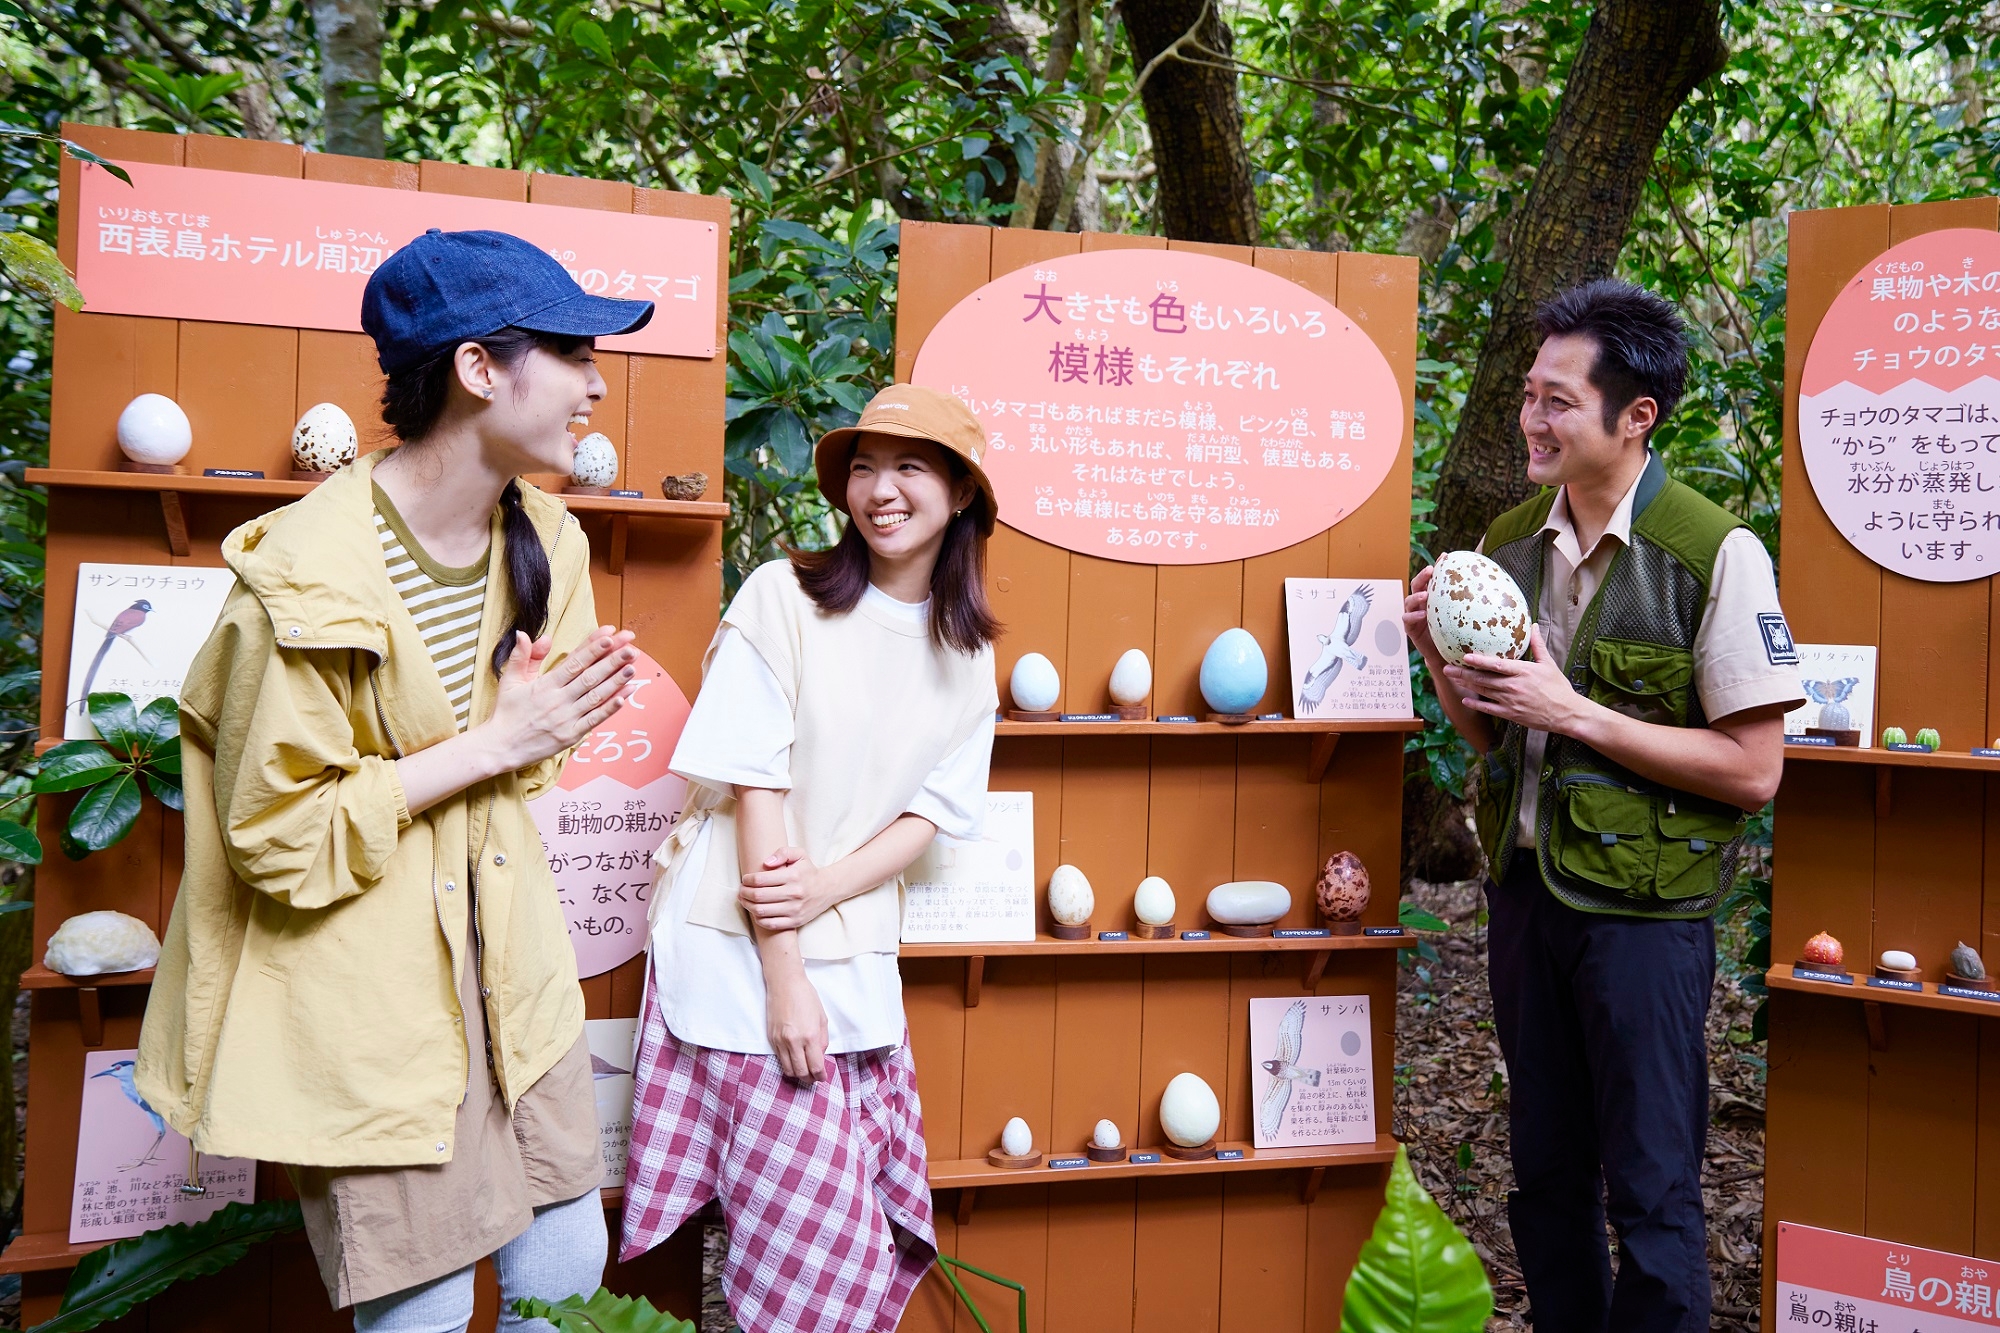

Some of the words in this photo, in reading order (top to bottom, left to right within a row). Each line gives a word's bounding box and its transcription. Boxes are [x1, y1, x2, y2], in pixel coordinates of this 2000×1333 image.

[98, 206, 211, 229] いりおもてじま
[315, 225, 389, 245] しゅうへん
[98, 221, 394, 276] 西表島ホテル周辺
[1874, 260, 1924, 276] くだもの
[1962, 256, 1974, 270] き
[1033, 268, 1057, 282] おお
[1156, 280, 1179, 292] いろ
[1869, 270, 2000, 302] 果物や木の
[1022, 282, 1327, 339] 大きさも色もいろいろ
[1893, 305, 2000, 334] のような
[1075, 327, 1109, 342] もよう
[1047, 341, 1281, 391] 模様もそれぞれ
[1184, 400, 1213, 411] もよう
[1290, 407, 1309, 418] いろ
[1329, 409, 1366, 421] あおいろ
[1820, 402, 1999, 428] チョウのタマゴは、
[1029, 422, 1047, 434] まる
[1065, 425, 1093, 437] かたち
[1187, 432, 1240, 445] だえんがた
[1260, 436, 1304, 450] たわらがた
[1072, 463, 1246, 491] それはなぜでしょう。
[1850, 461, 1896, 472] すいぶん
[1919, 460, 1975, 472] じょうはつ
[1847, 471, 2000, 495] 水分が蒸発し
[1034, 485, 1054, 497] いろ
[1078, 488, 1108, 500] もよう
[1147, 491, 1175, 503] いのち
[1191, 493, 1209, 505] まも
[1229, 495, 1261, 507] ひみつ
[1932, 498, 1955, 510] まも
[1034, 496, 1280, 528] 色や模様にも命を守る秘密が
[1864, 510, 2000, 532] ように守られ
[1106, 526, 1208, 550] あるのです。
[1902, 540, 1984, 562] います。
[88, 573, 205, 591] サンコウチョウ
[1295, 588, 1337, 600] ミサゴ
[1798, 652, 1864, 662] ルリタテハ
[625, 679, 652, 710] て
[558, 801, 602, 813] どうぶつ
[623, 799, 646, 811] おや
[1321, 1003, 1364, 1016] サシバ
[1886, 1251, 1910, 1266] とり
[1960, 1266, 1988, 1281] おや
[1789, 1291, 1807, 1303] とり
[1834, 1300, 1856, 1313] おや
[1880, 1266, 2000, 1319] 鳥の親
[1788, 1302, 1879, 1333] 鳥の親は
